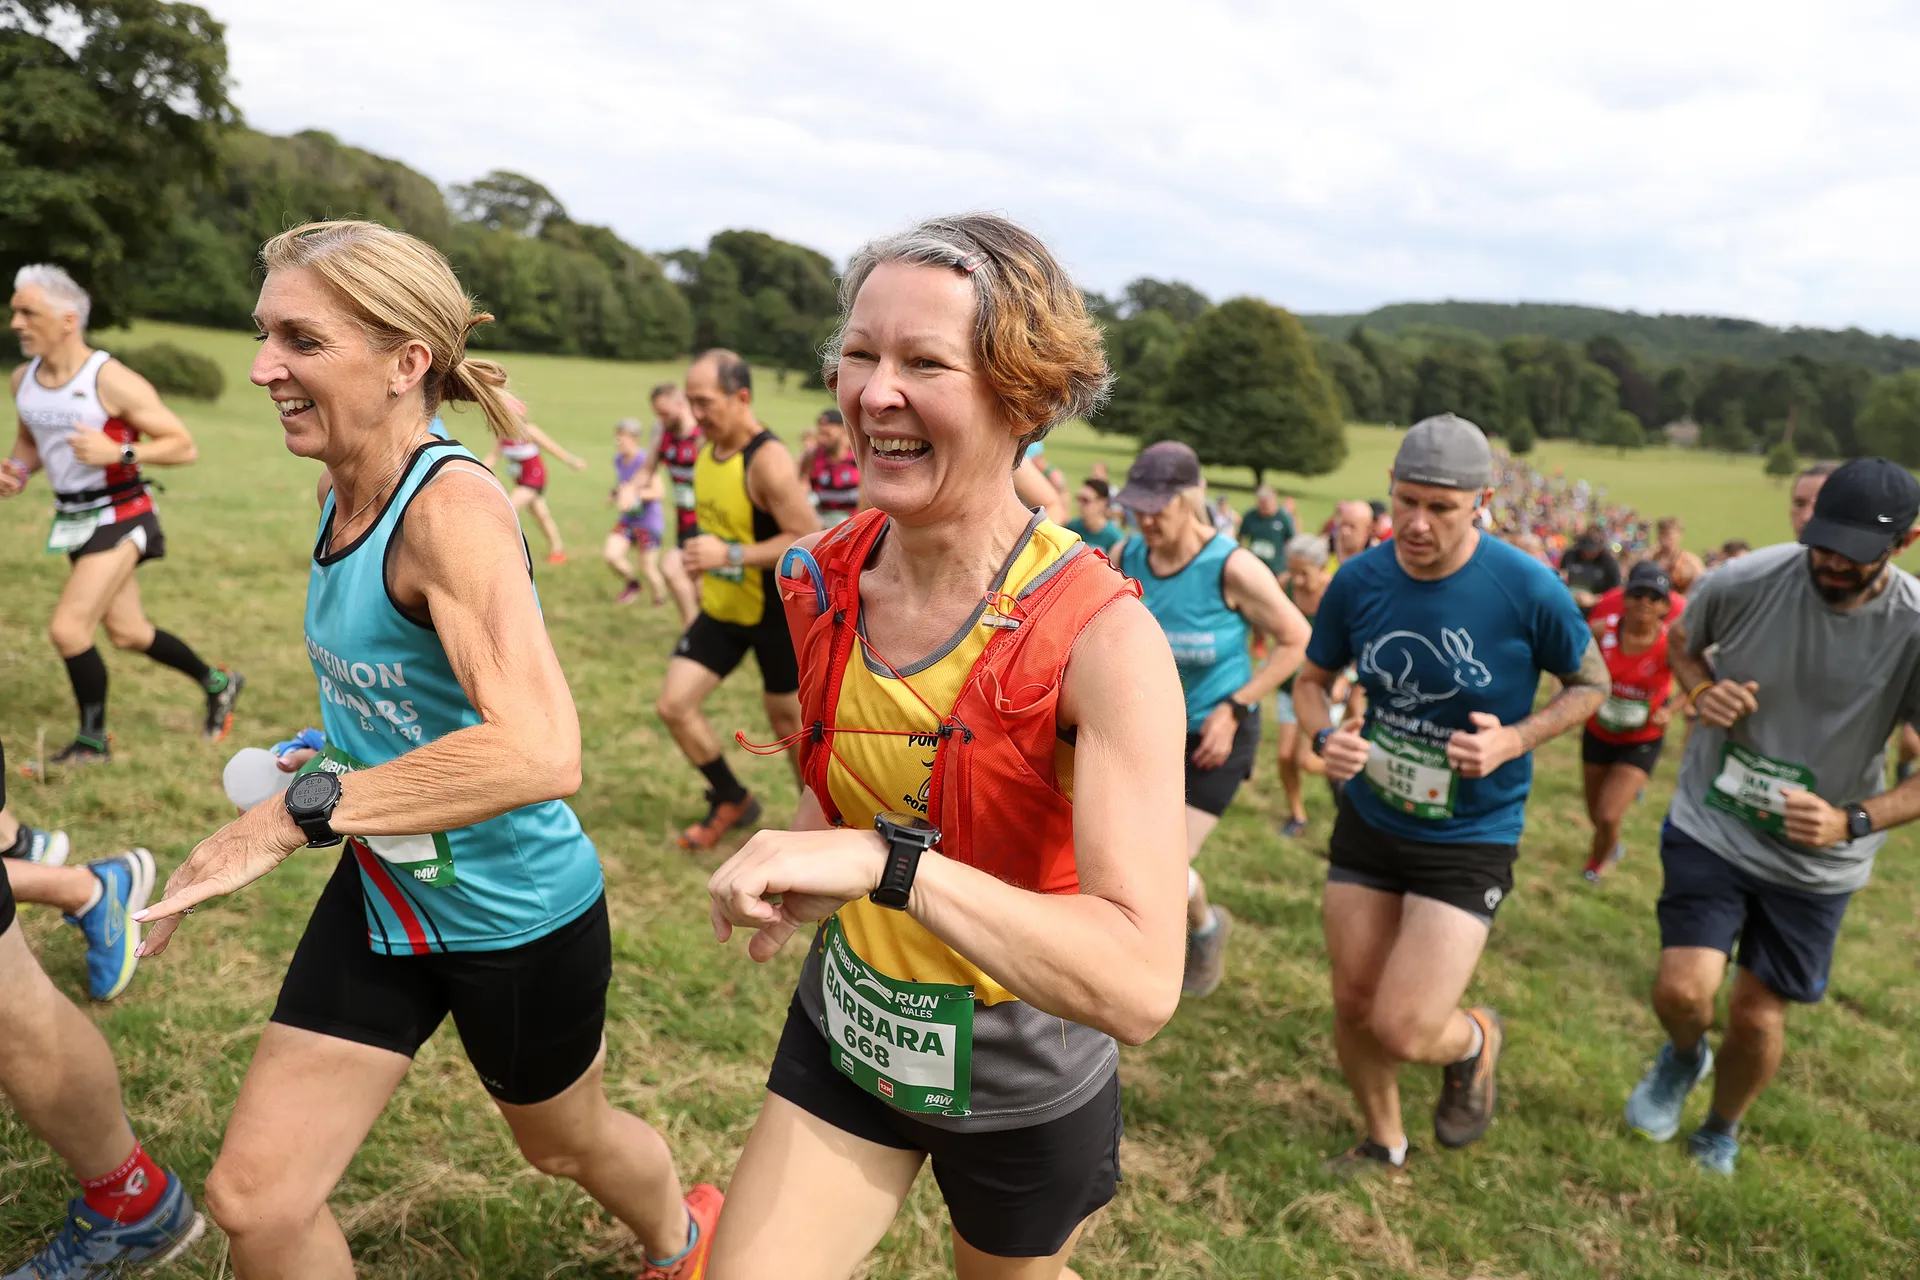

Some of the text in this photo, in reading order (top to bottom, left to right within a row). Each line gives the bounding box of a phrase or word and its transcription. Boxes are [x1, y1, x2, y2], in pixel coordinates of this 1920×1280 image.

[414, 866, 439, 880] R4W
[833, 933, 940, 1009] RABBIT RUN
[826, 962, 945, 1057] BARBARA
[900, 1005, 933, 1019] WALES
[844, 1024, 890, 1069] 668
[925, 1094, 953, 1106] R4W
